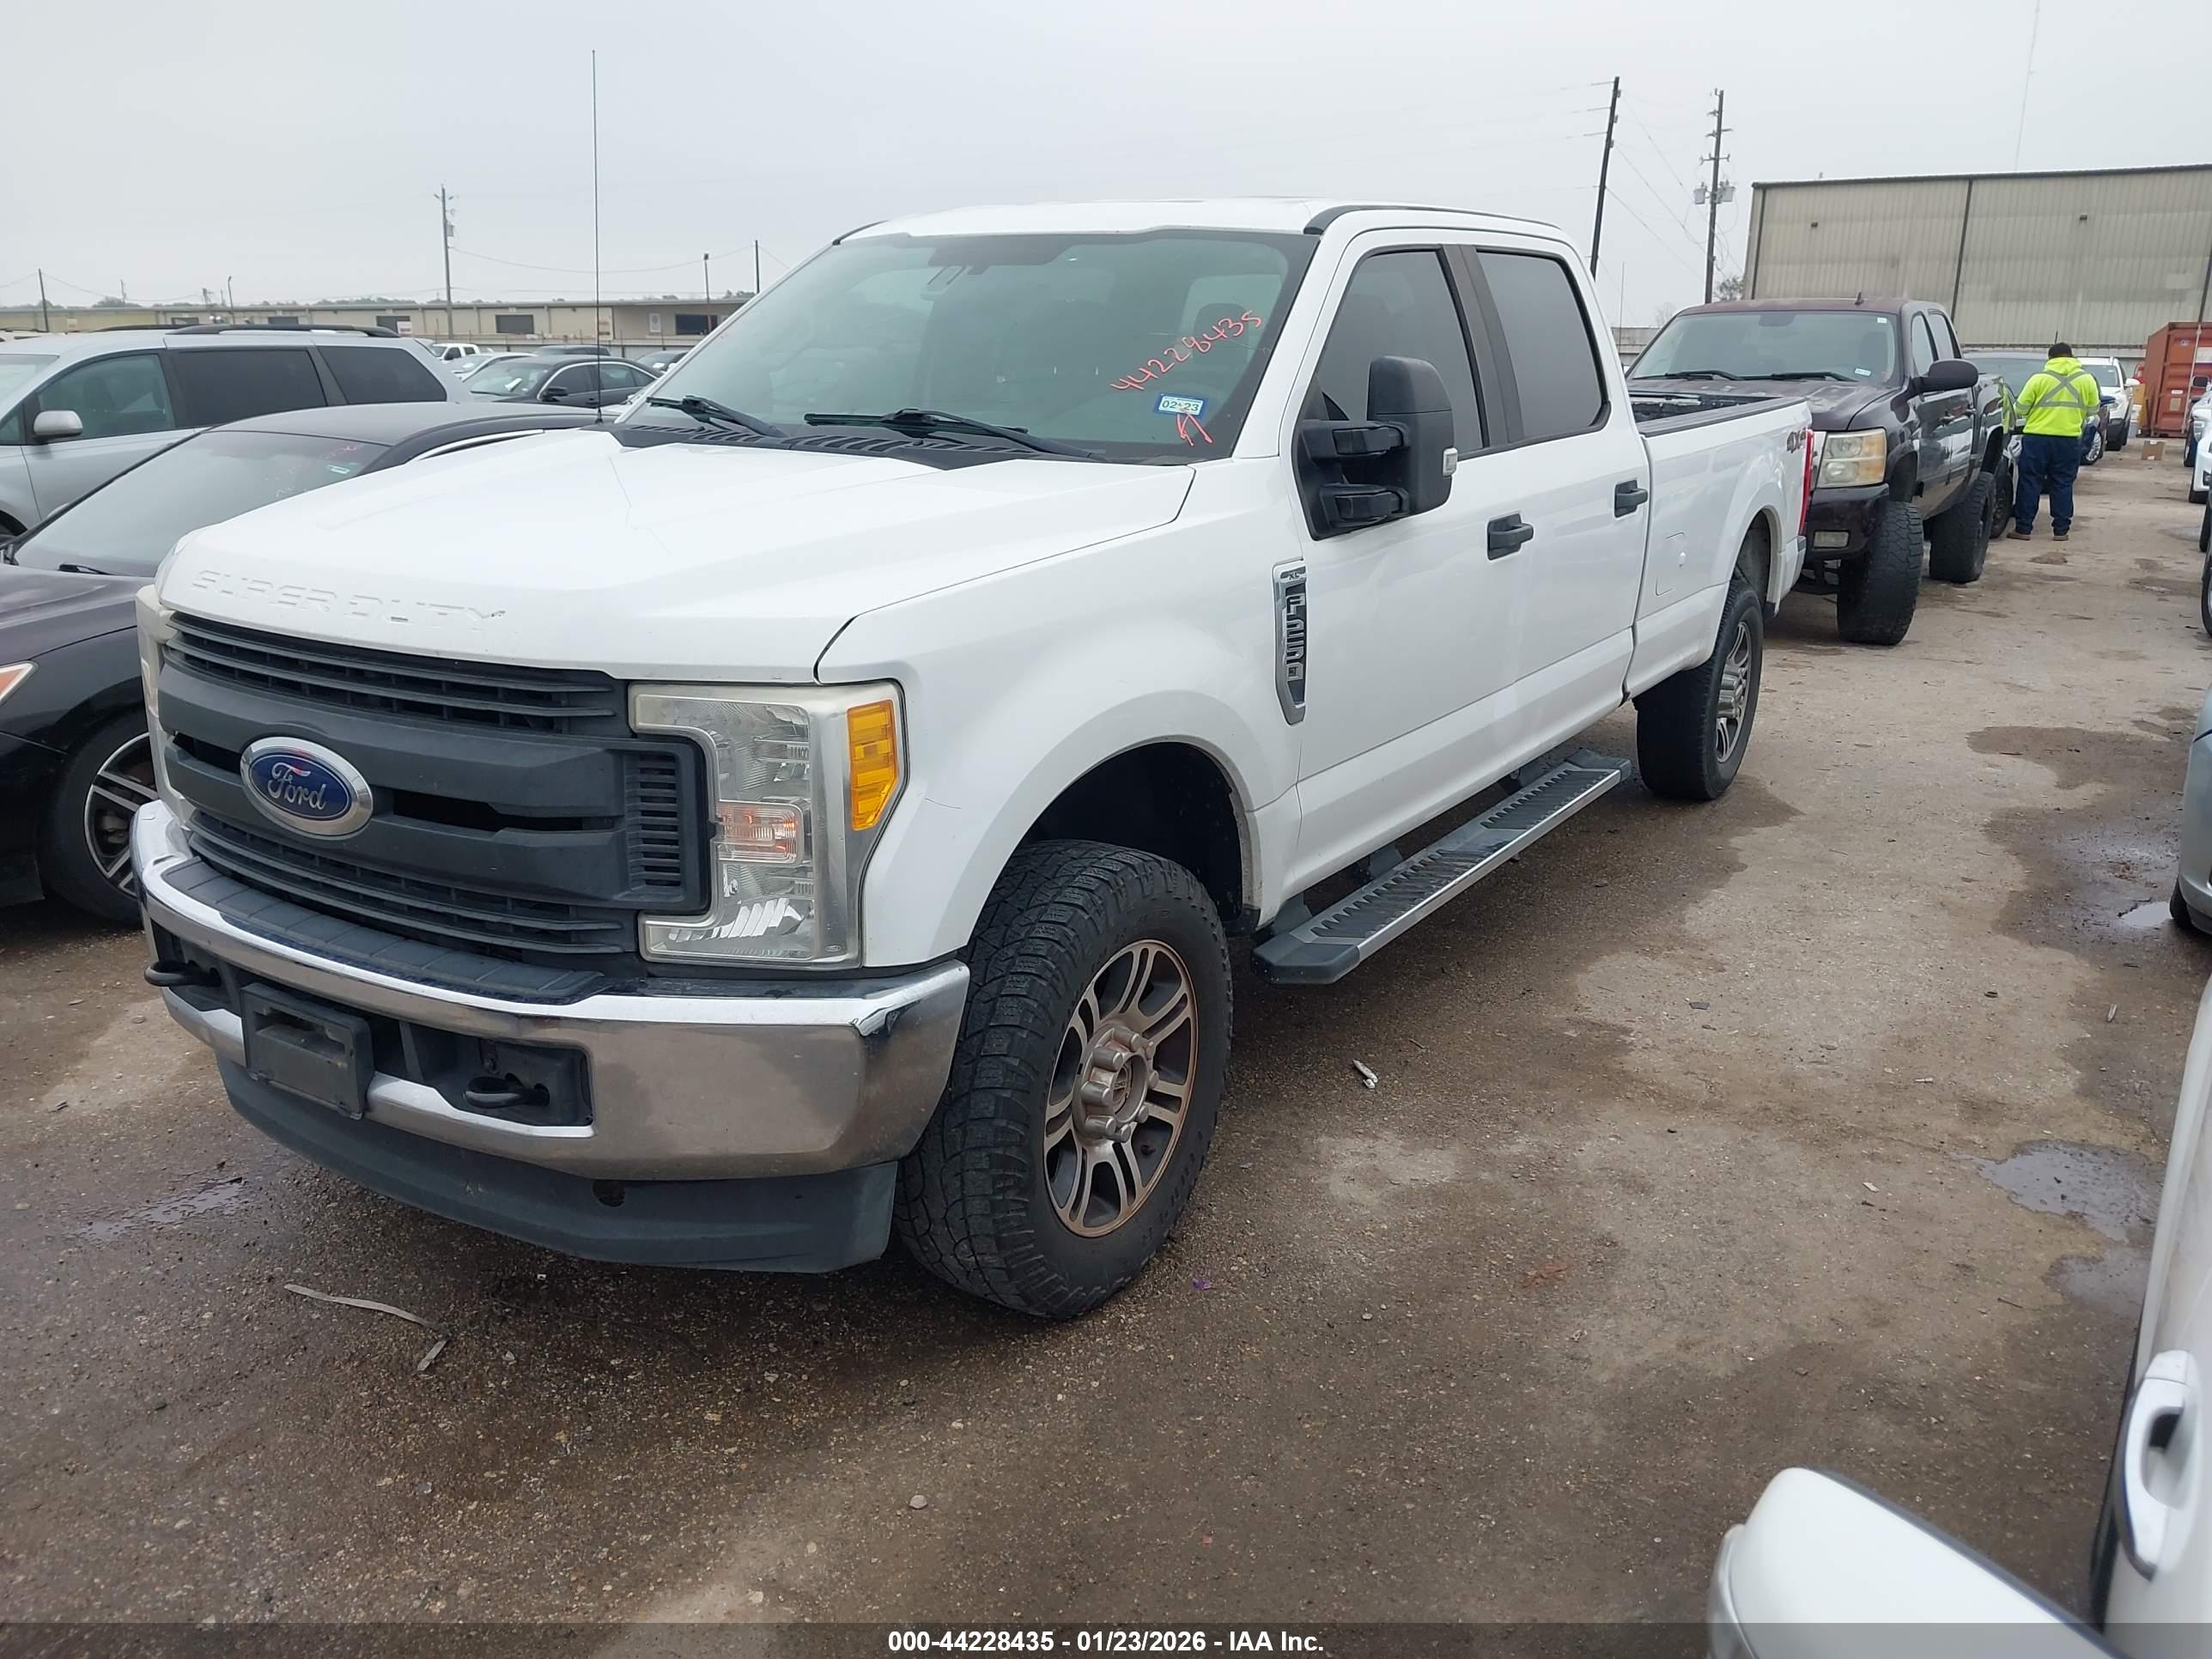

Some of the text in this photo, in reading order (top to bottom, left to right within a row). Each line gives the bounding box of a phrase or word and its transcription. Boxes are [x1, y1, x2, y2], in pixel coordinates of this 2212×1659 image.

[1109, 309, 1263, 391] 44228435
[1161, 399, 1178, 410] 02
[1183, 402, 1200, 412] 23
[1288, 571, 1300, 580] XL
[192, 569, 507, 632] SUPER DUTY
[267, 762, 327, 811] Ford
